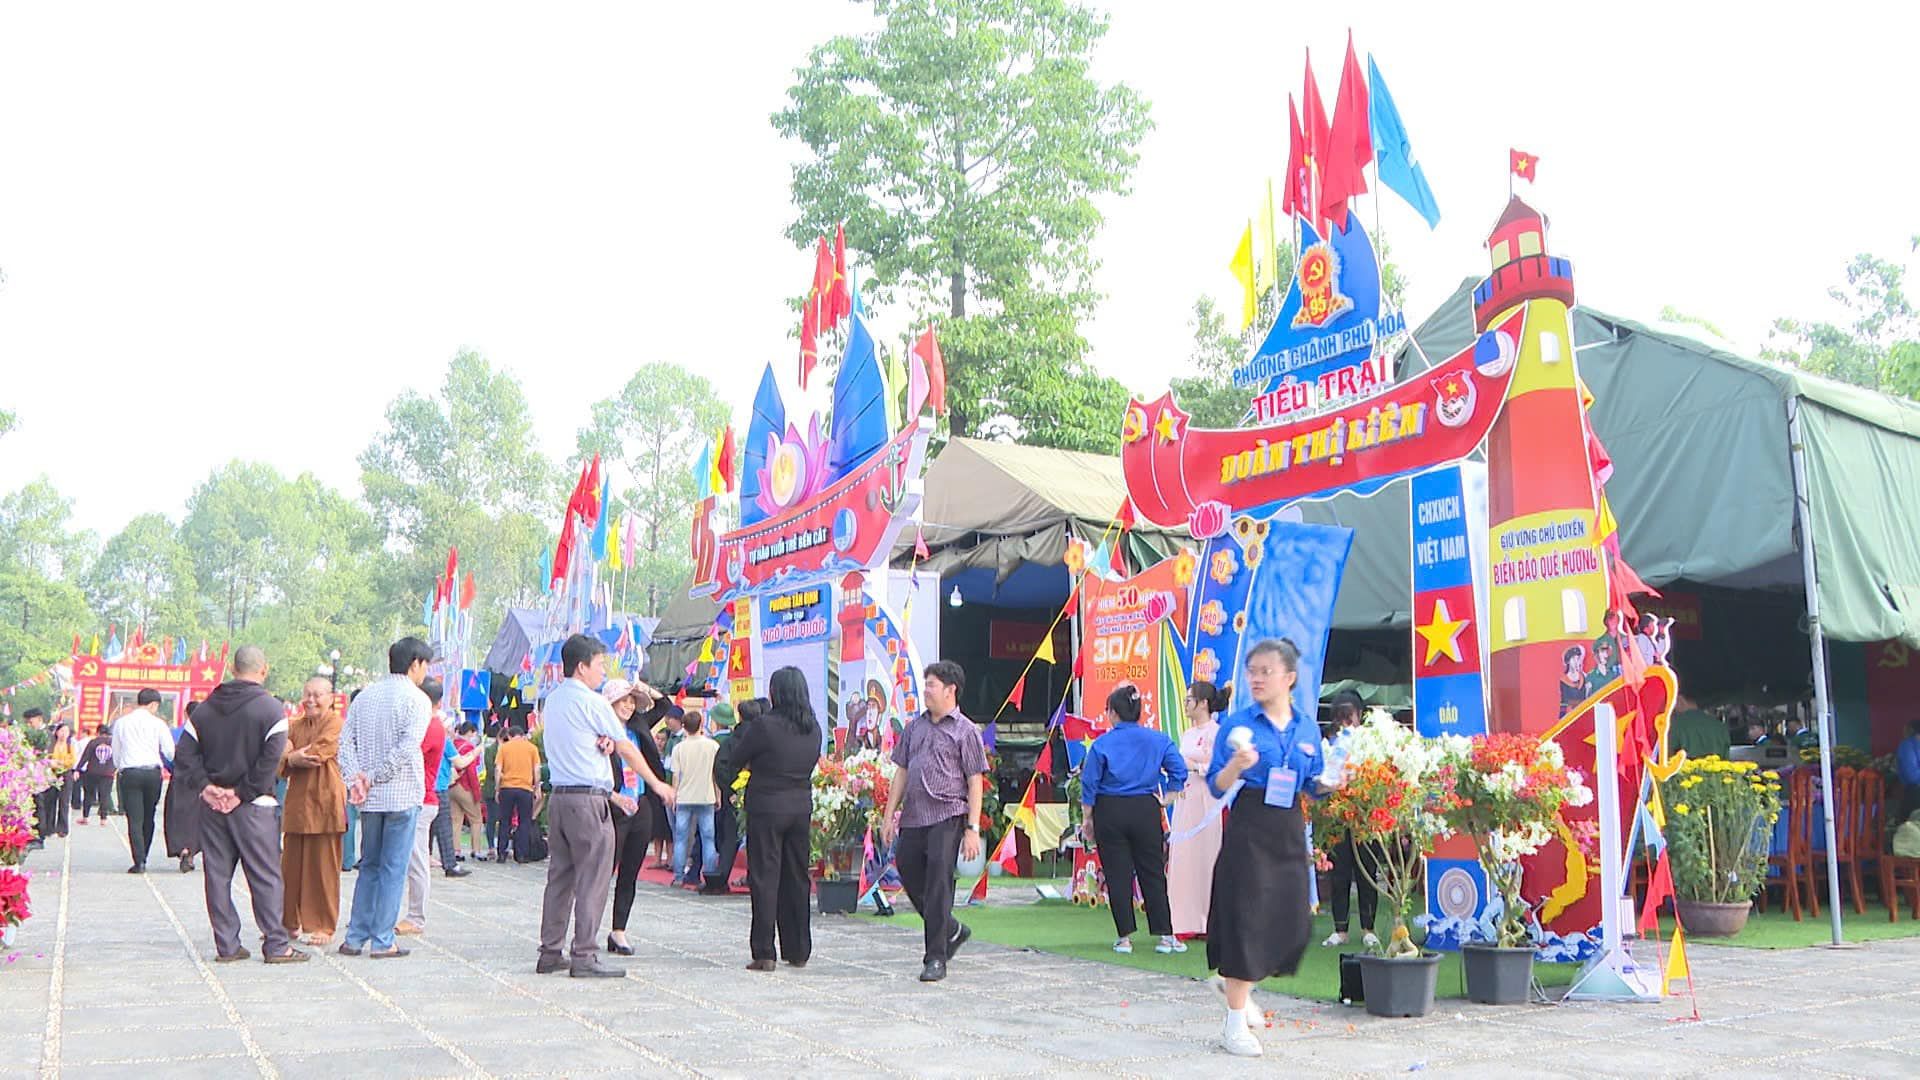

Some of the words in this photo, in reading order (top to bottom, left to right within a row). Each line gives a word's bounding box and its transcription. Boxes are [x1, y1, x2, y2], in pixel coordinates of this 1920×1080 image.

[1233, 351, 1286, 387] PHƯỜNG
[1290, 336, 1337, 367] CHÁNH
[1342, 319, 1371, 349] PHÚ
[1252, 375, 1308, 421] TIỂU
[1319, 354, 1386, 400] TRẠI
[1220, 438, 1291, 485] ĐOÀN
[1292, 416, 1347, 467] THỊ
[1347, 400, 1427, 451] LIÊN
[1418, 495, 1460, 526] CHXHCN
[798, 530, 812, 550] BẾN
[813, 526, 828, 545] CÁT
[1417, 535, 1439, 570] VIỆT
[1440, 535, 1466, 563] NAM
[1493, 553, 1516, 585] BIỂN
[1518, 551, 1538, 581] ĐẢO
[1540, 550, 1559, 580] QUÊ
[1561, 547, 1598, 575] HƯƠNG
[1118, 586, 1139, 609] 50
[1093, 631, 1151, 664] 30/4
[1096, 666, 1117, 680] 1975
[1126, 664, 1149, 679] 2025
[1439, 700, 1458, 724] ĐẢO
